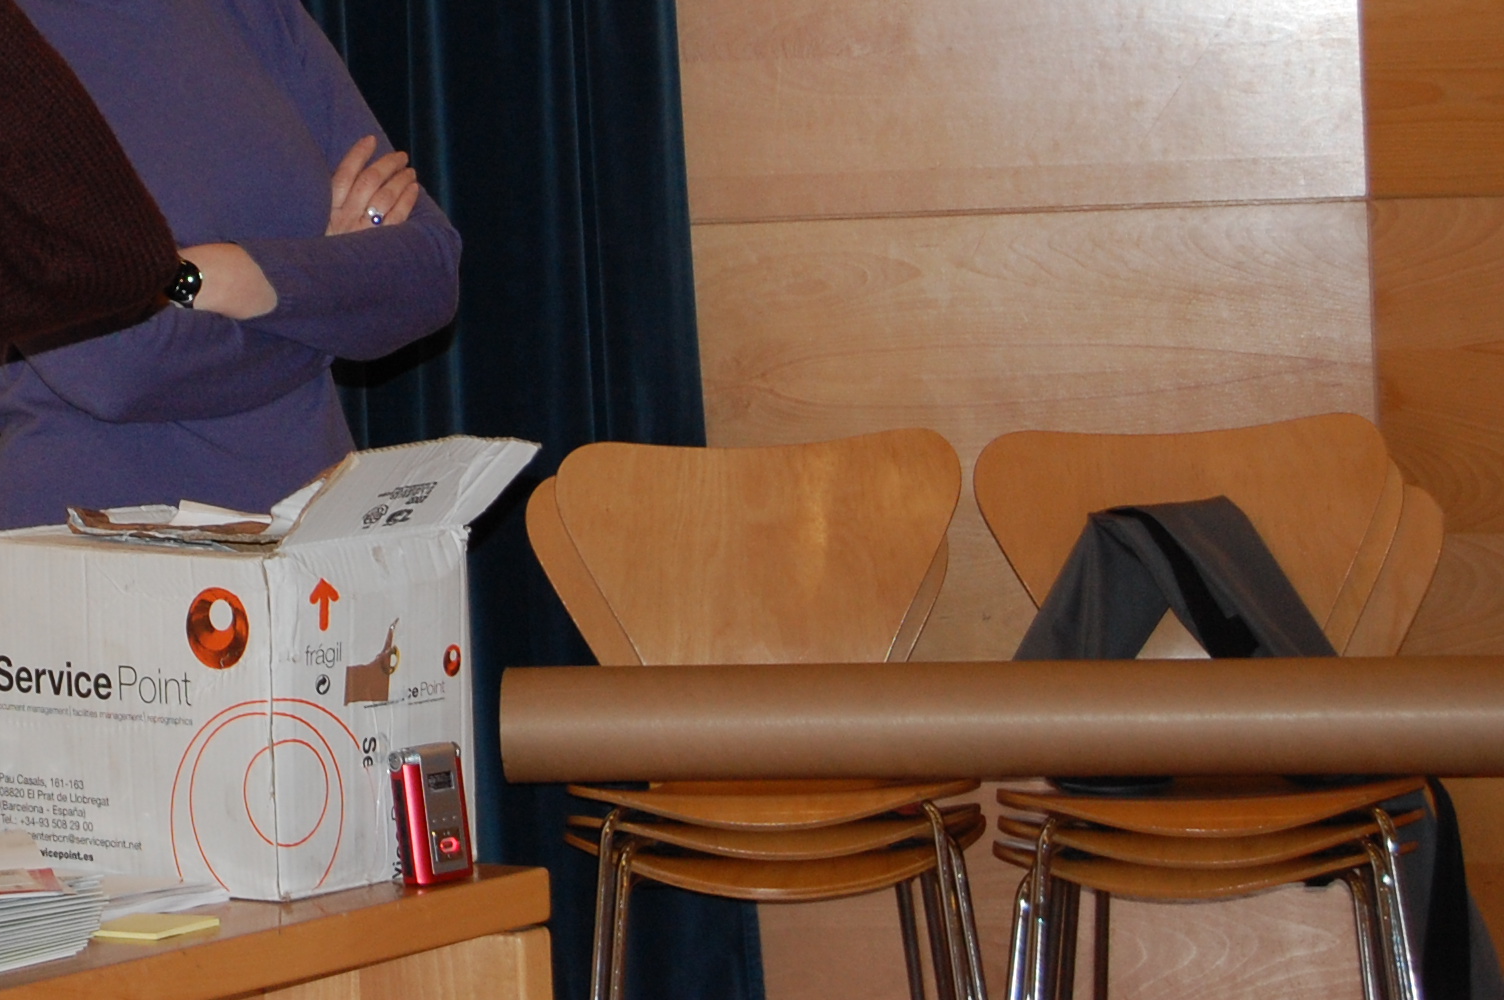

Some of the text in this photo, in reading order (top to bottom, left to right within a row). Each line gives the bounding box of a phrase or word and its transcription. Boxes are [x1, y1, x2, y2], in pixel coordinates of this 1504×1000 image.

[306, 642, 343, 668] frágil
[118, 665, 192, 706] Point
[37, 790, 55, 801] Prat
[57, 791, 68, 802] de
[69, 793, 110, 808] Llobregat
[52, 818, 68, 829] 508
[82, 821, 94, 832] 00
[40, 847, 94, 862] vicepoint.es
